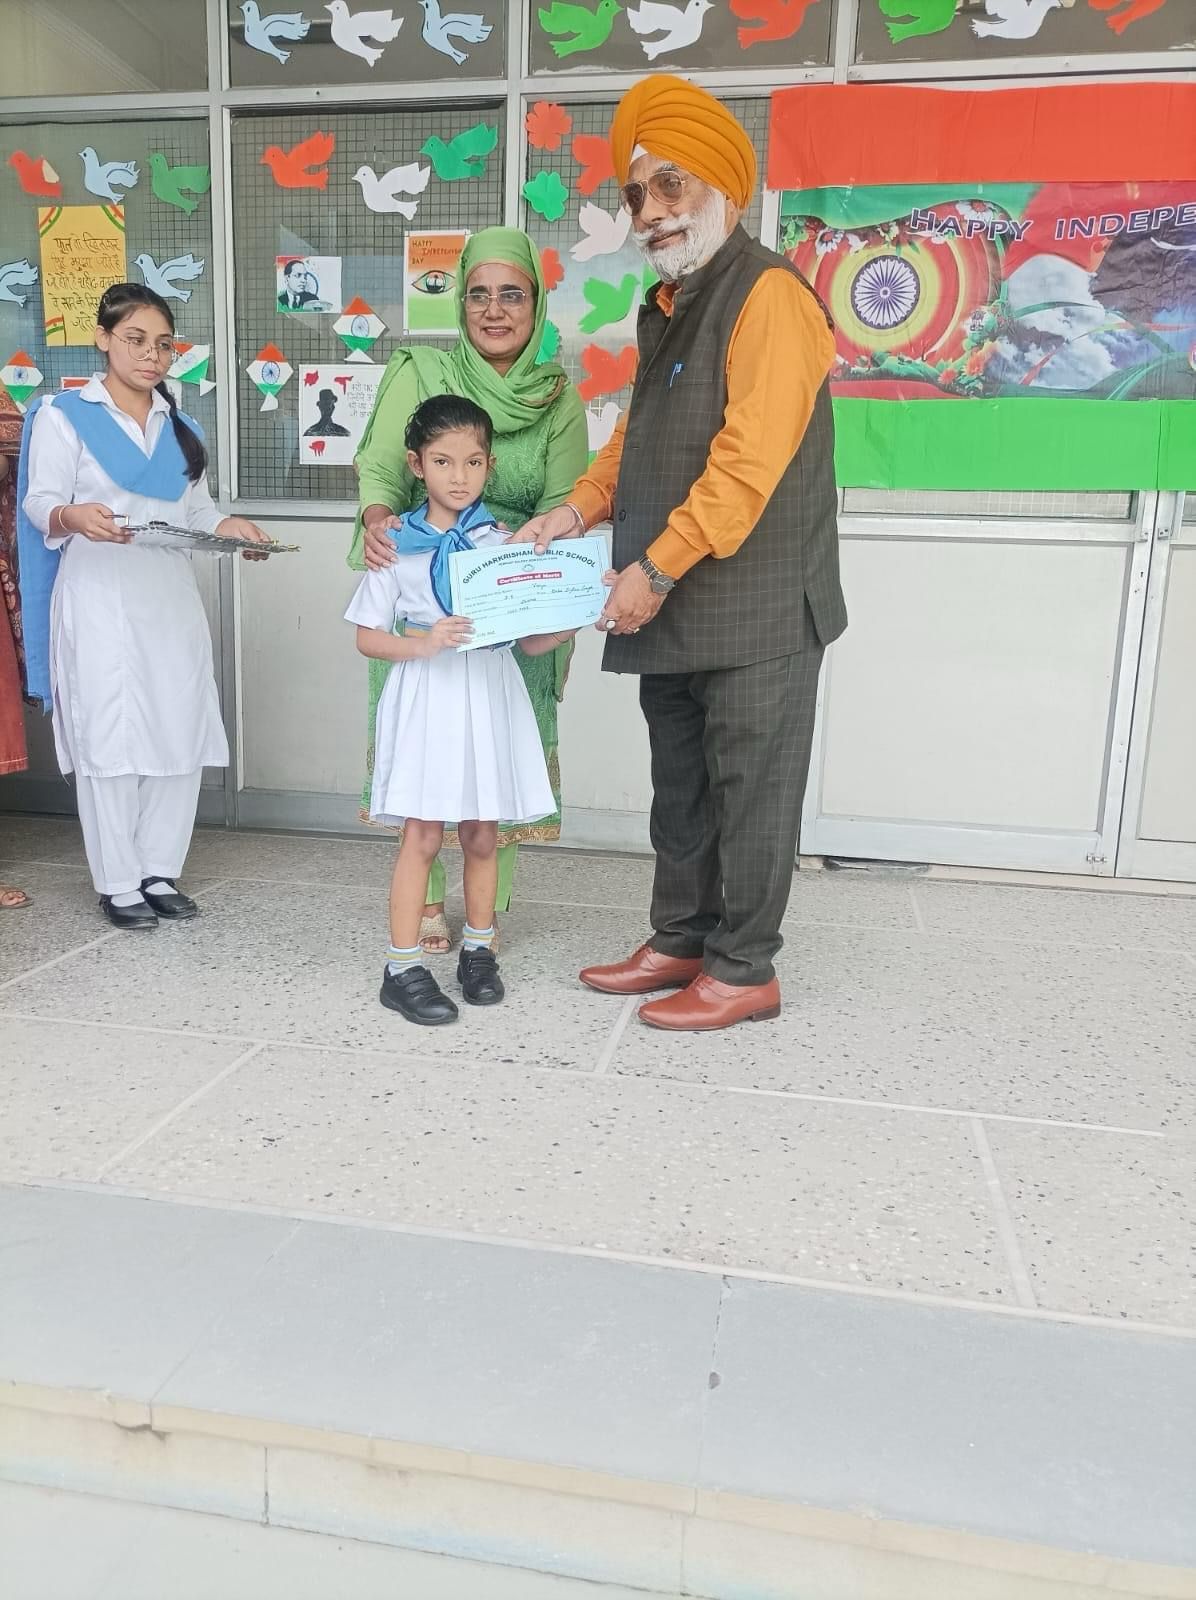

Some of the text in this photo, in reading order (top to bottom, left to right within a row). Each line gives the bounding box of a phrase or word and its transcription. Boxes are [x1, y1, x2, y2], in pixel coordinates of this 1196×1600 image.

[911, 208, 1034, 242] HAPPY
[462, 566, 483, 584] GURU
[481, 549, 533, 569] HARKRISHAN
[565, 551, 596, 568] SCHOOL
